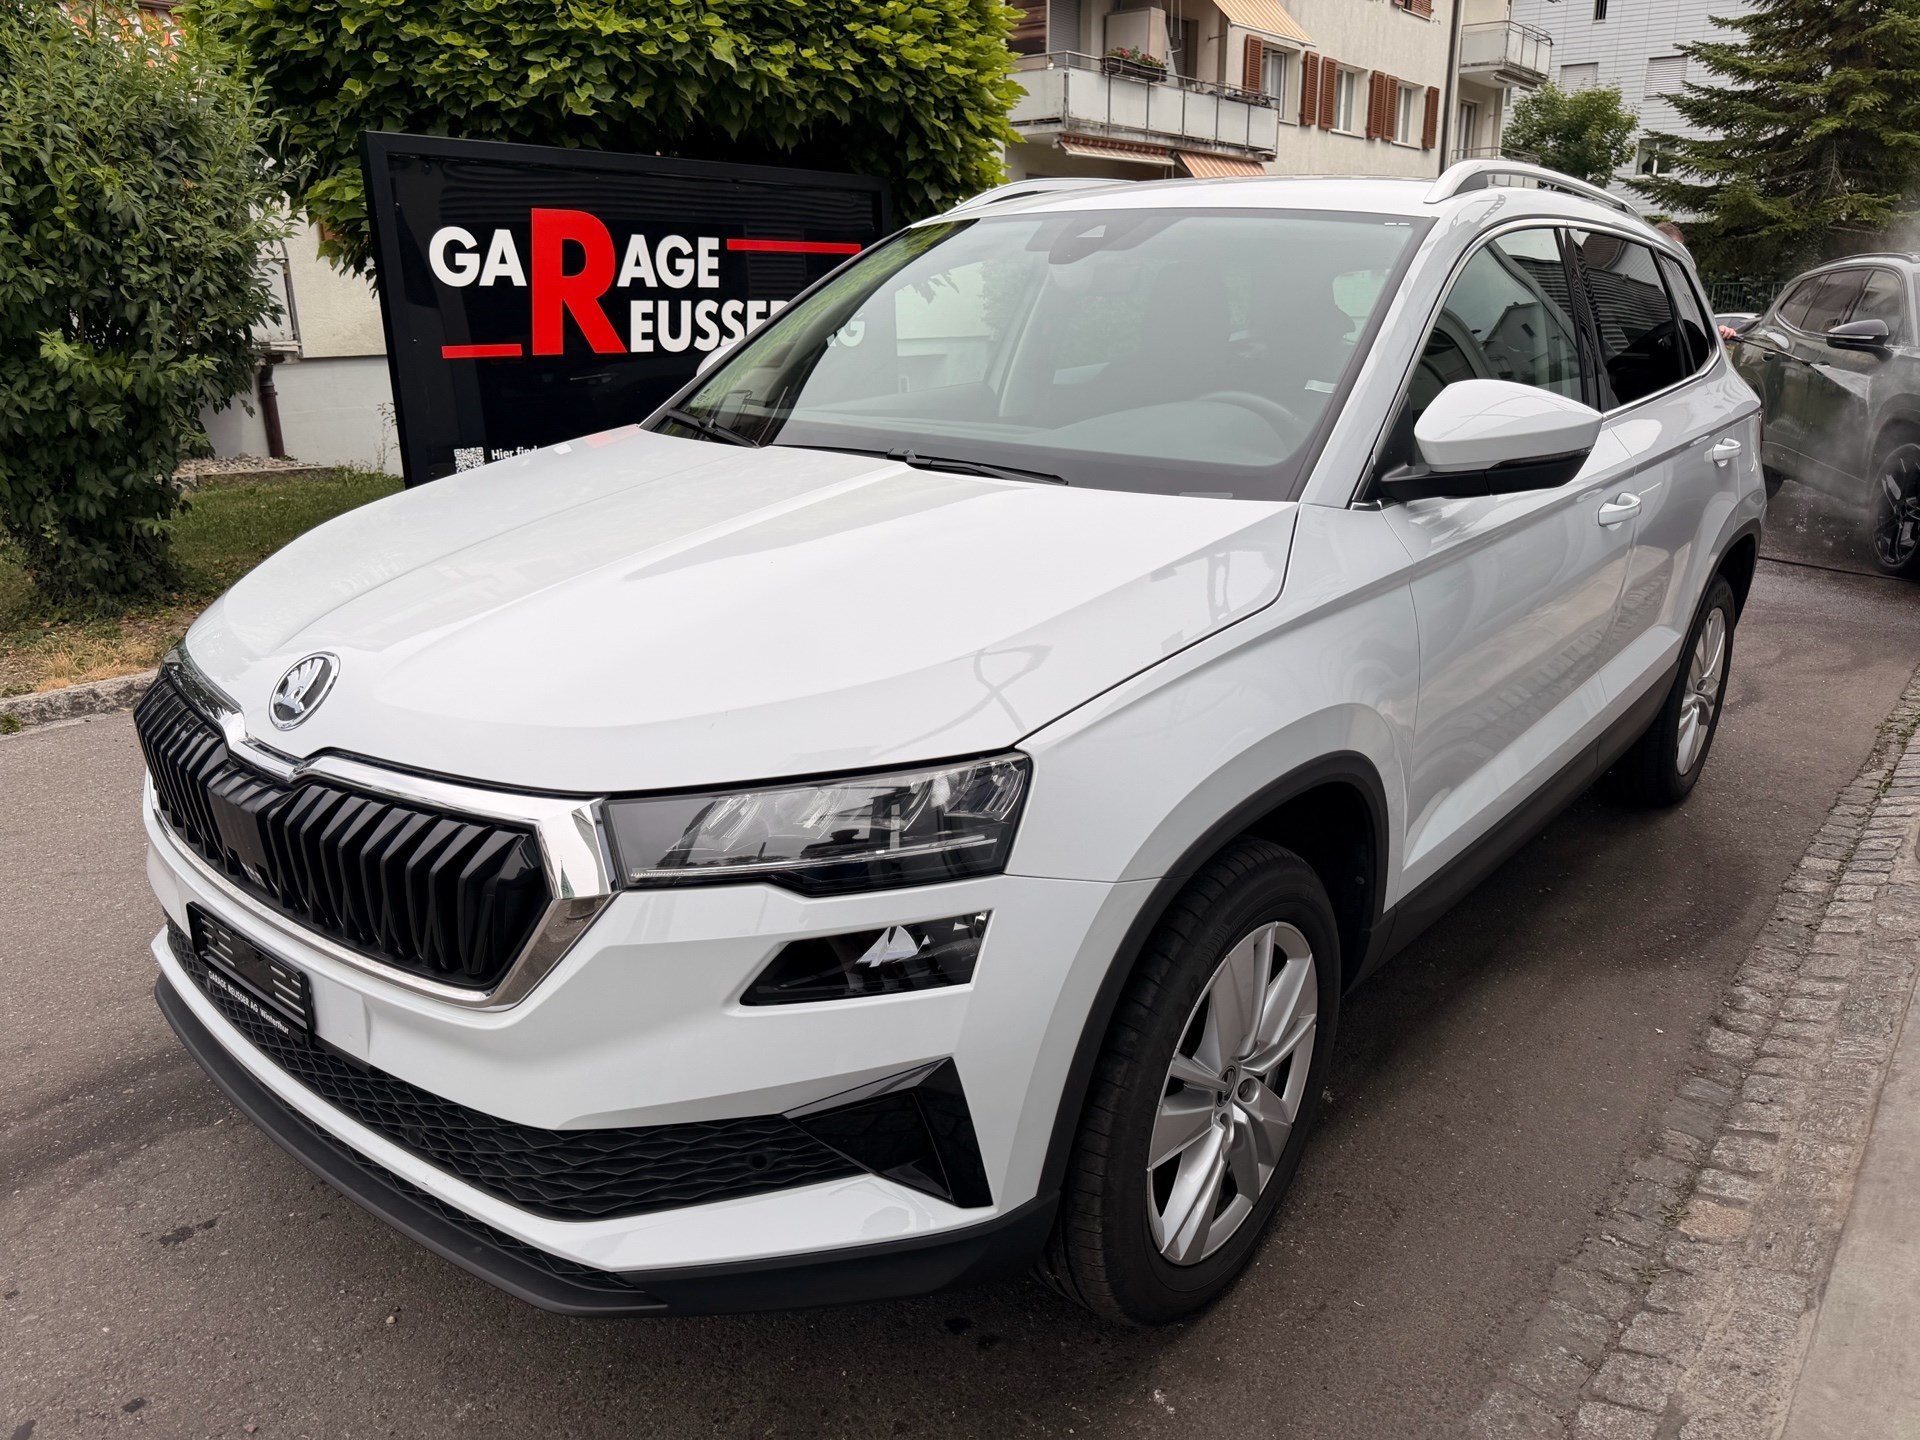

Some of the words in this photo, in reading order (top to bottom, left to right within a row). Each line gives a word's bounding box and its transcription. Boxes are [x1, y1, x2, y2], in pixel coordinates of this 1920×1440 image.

[429, 207, 720, 355] GARAGE
[491, 448, 514, 460] Hier
[208, 970, 227, 990] GARAGE
[227, 984, 250, 1007] REUSSER
[250, 1001, 259, 1013] AG
[260, 1008, 289, 1035] Winterthur
